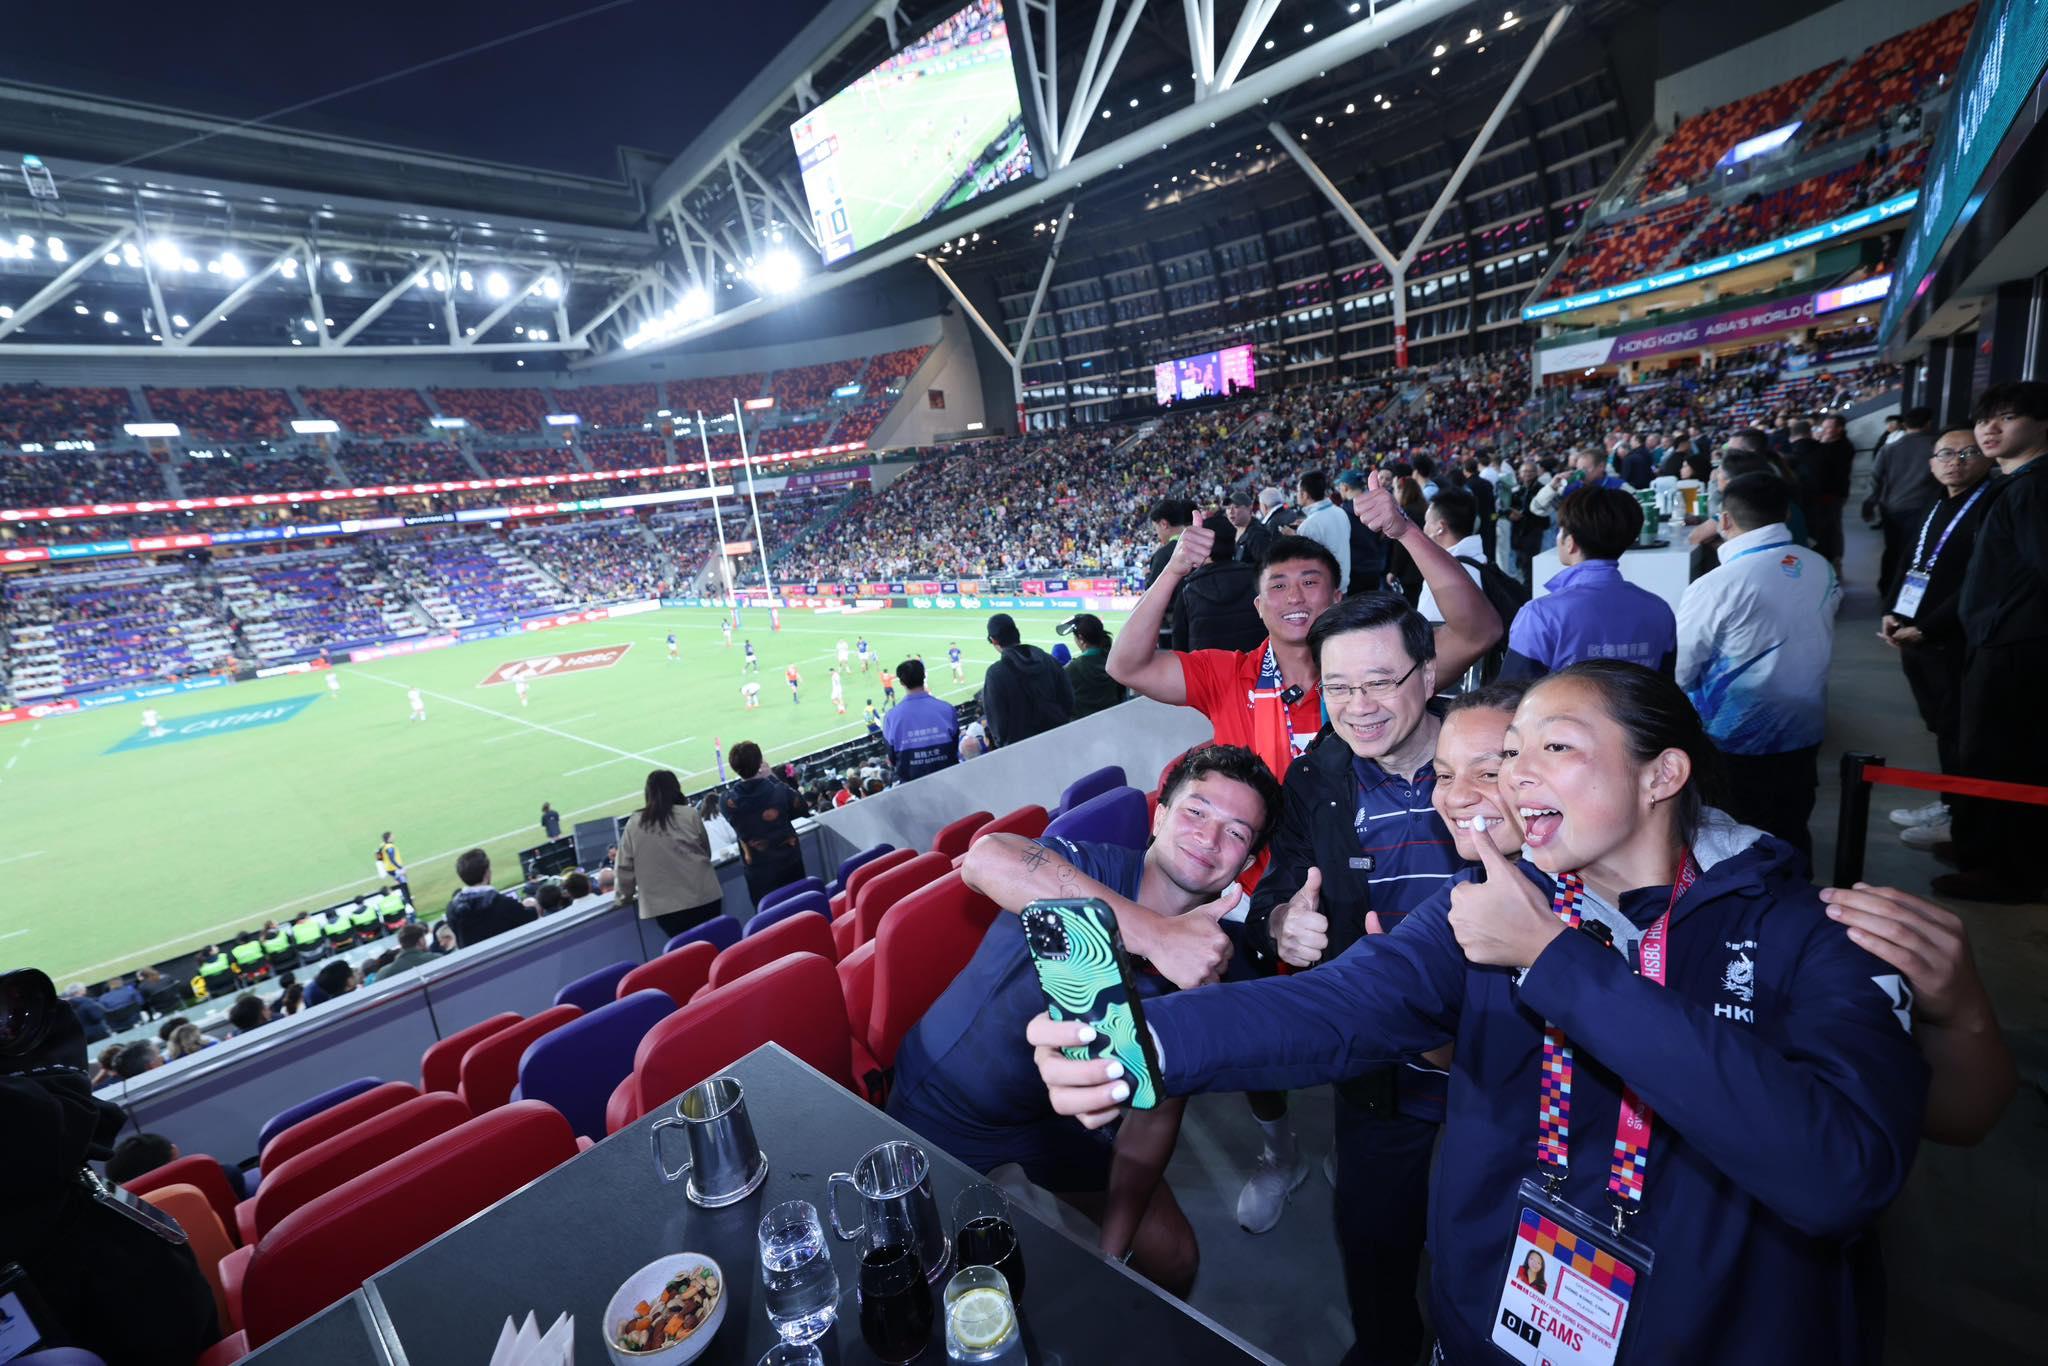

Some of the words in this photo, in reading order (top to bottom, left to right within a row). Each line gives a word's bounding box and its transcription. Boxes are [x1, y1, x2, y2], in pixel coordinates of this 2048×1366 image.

[1618, 336, 1656, 353] HONG
[1657, 327, 1698, 345] KONG
[1751, 307, 1800, 326] WORLD
[562, 650, 619, 669] HSBC
[178, 704, 295, 735] CATHAY
[1644, 942, 1660, 977] HSBC
[1507, 1315, 1516, 1328] 0
[1527, 1329, 1534, 1341] 1
[1531, 1303, 1583, 1352] TEAMS
